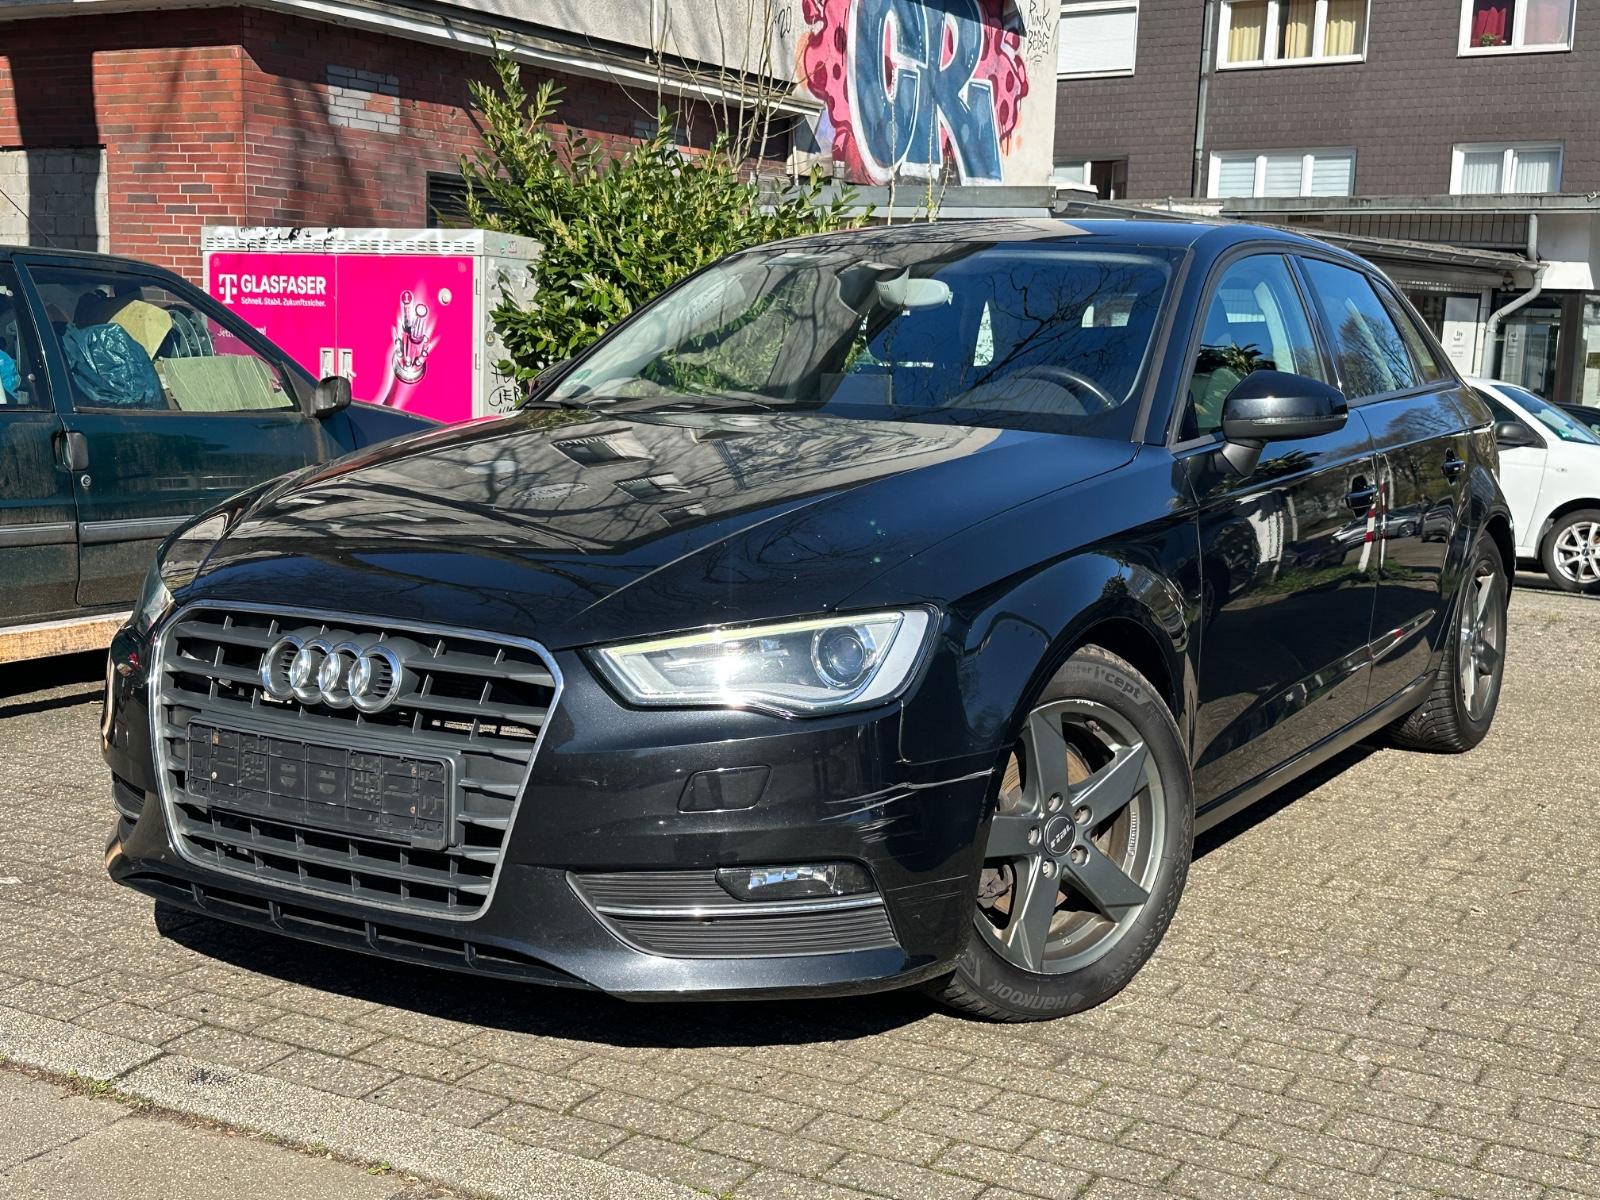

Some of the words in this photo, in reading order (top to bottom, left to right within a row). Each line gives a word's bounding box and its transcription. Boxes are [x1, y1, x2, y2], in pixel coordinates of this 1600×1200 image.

[240, 274, 327, 295] GLASFASER
[240, 296, 264, 306] Schnell.
[263, 297, 281, 306] Stabil.
[282, 298, 327, 307] Zukunftssicher.
